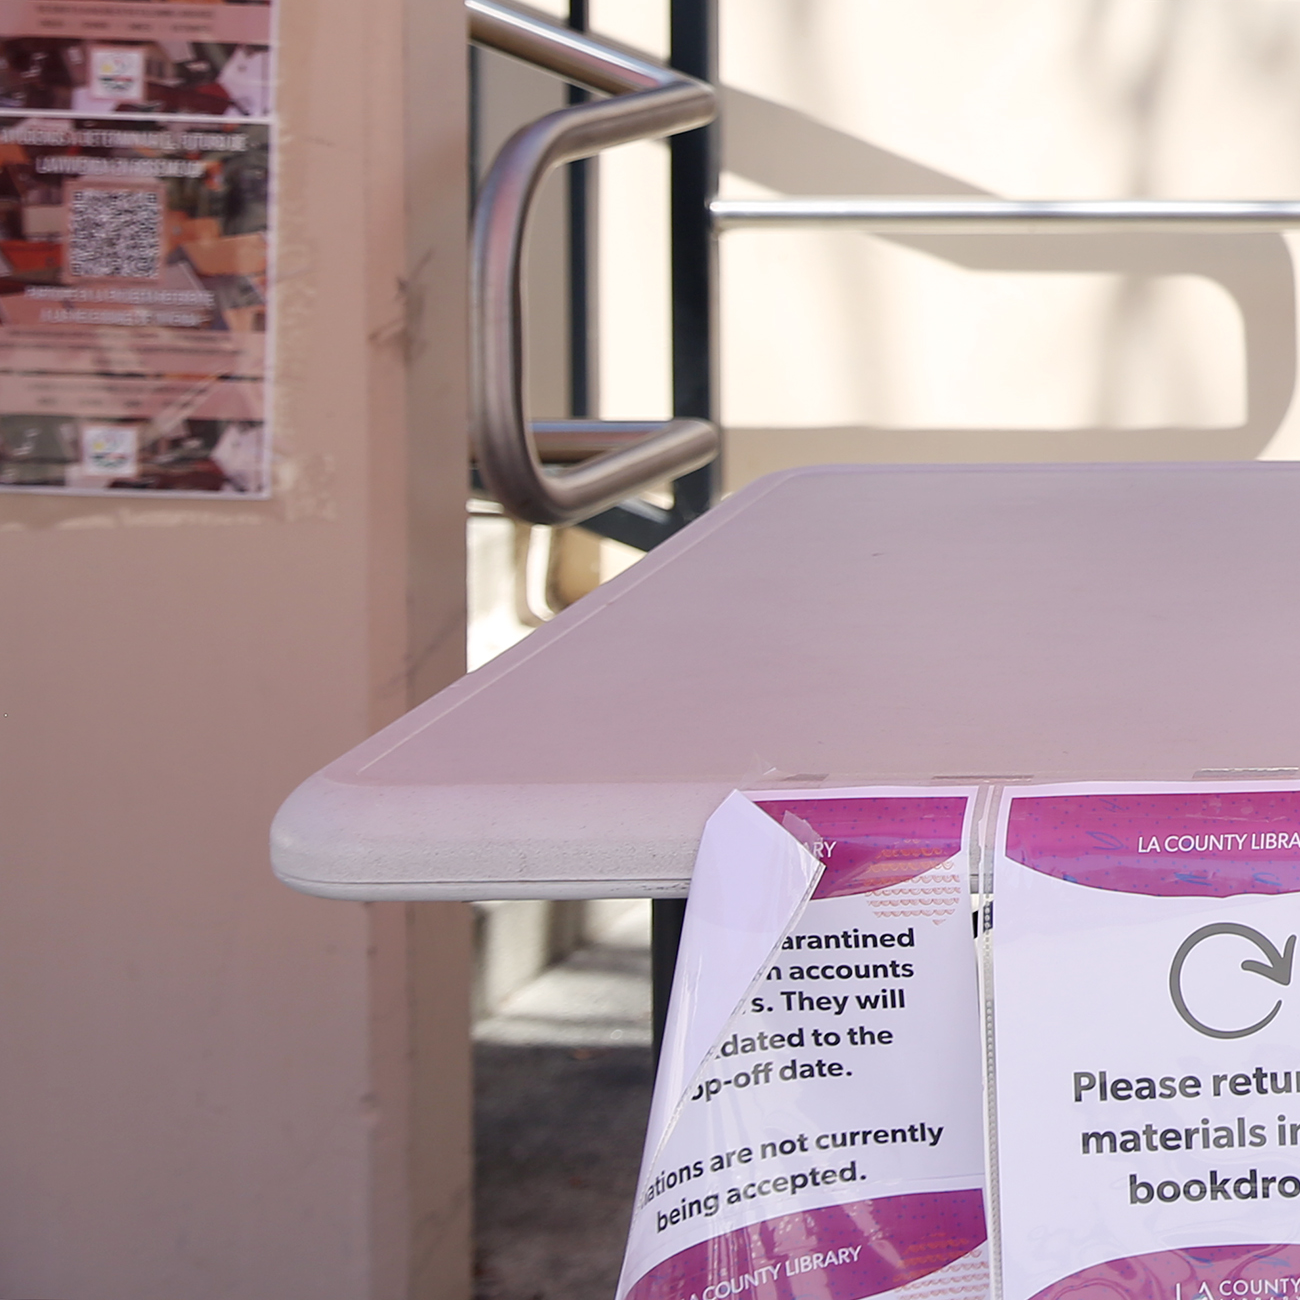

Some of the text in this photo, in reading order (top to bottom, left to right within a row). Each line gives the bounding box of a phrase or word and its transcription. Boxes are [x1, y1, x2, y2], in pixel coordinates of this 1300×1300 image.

[789, 960, 915, 981] accounts
[779, 988, 905, 1016] They will
[811, 1025, 894, 1047] to the
[779, 1059, 852, 1081] date.
[1073, 1070, 1202, 1103] Please
[711, 1123, 943, 1172] are not currently
[1081, 1117, 1267, 1155] materials
[657, 1161, 866, 1233] being accepted.
[702, 1246, 862, 1300] COUNTY LIBRARY
